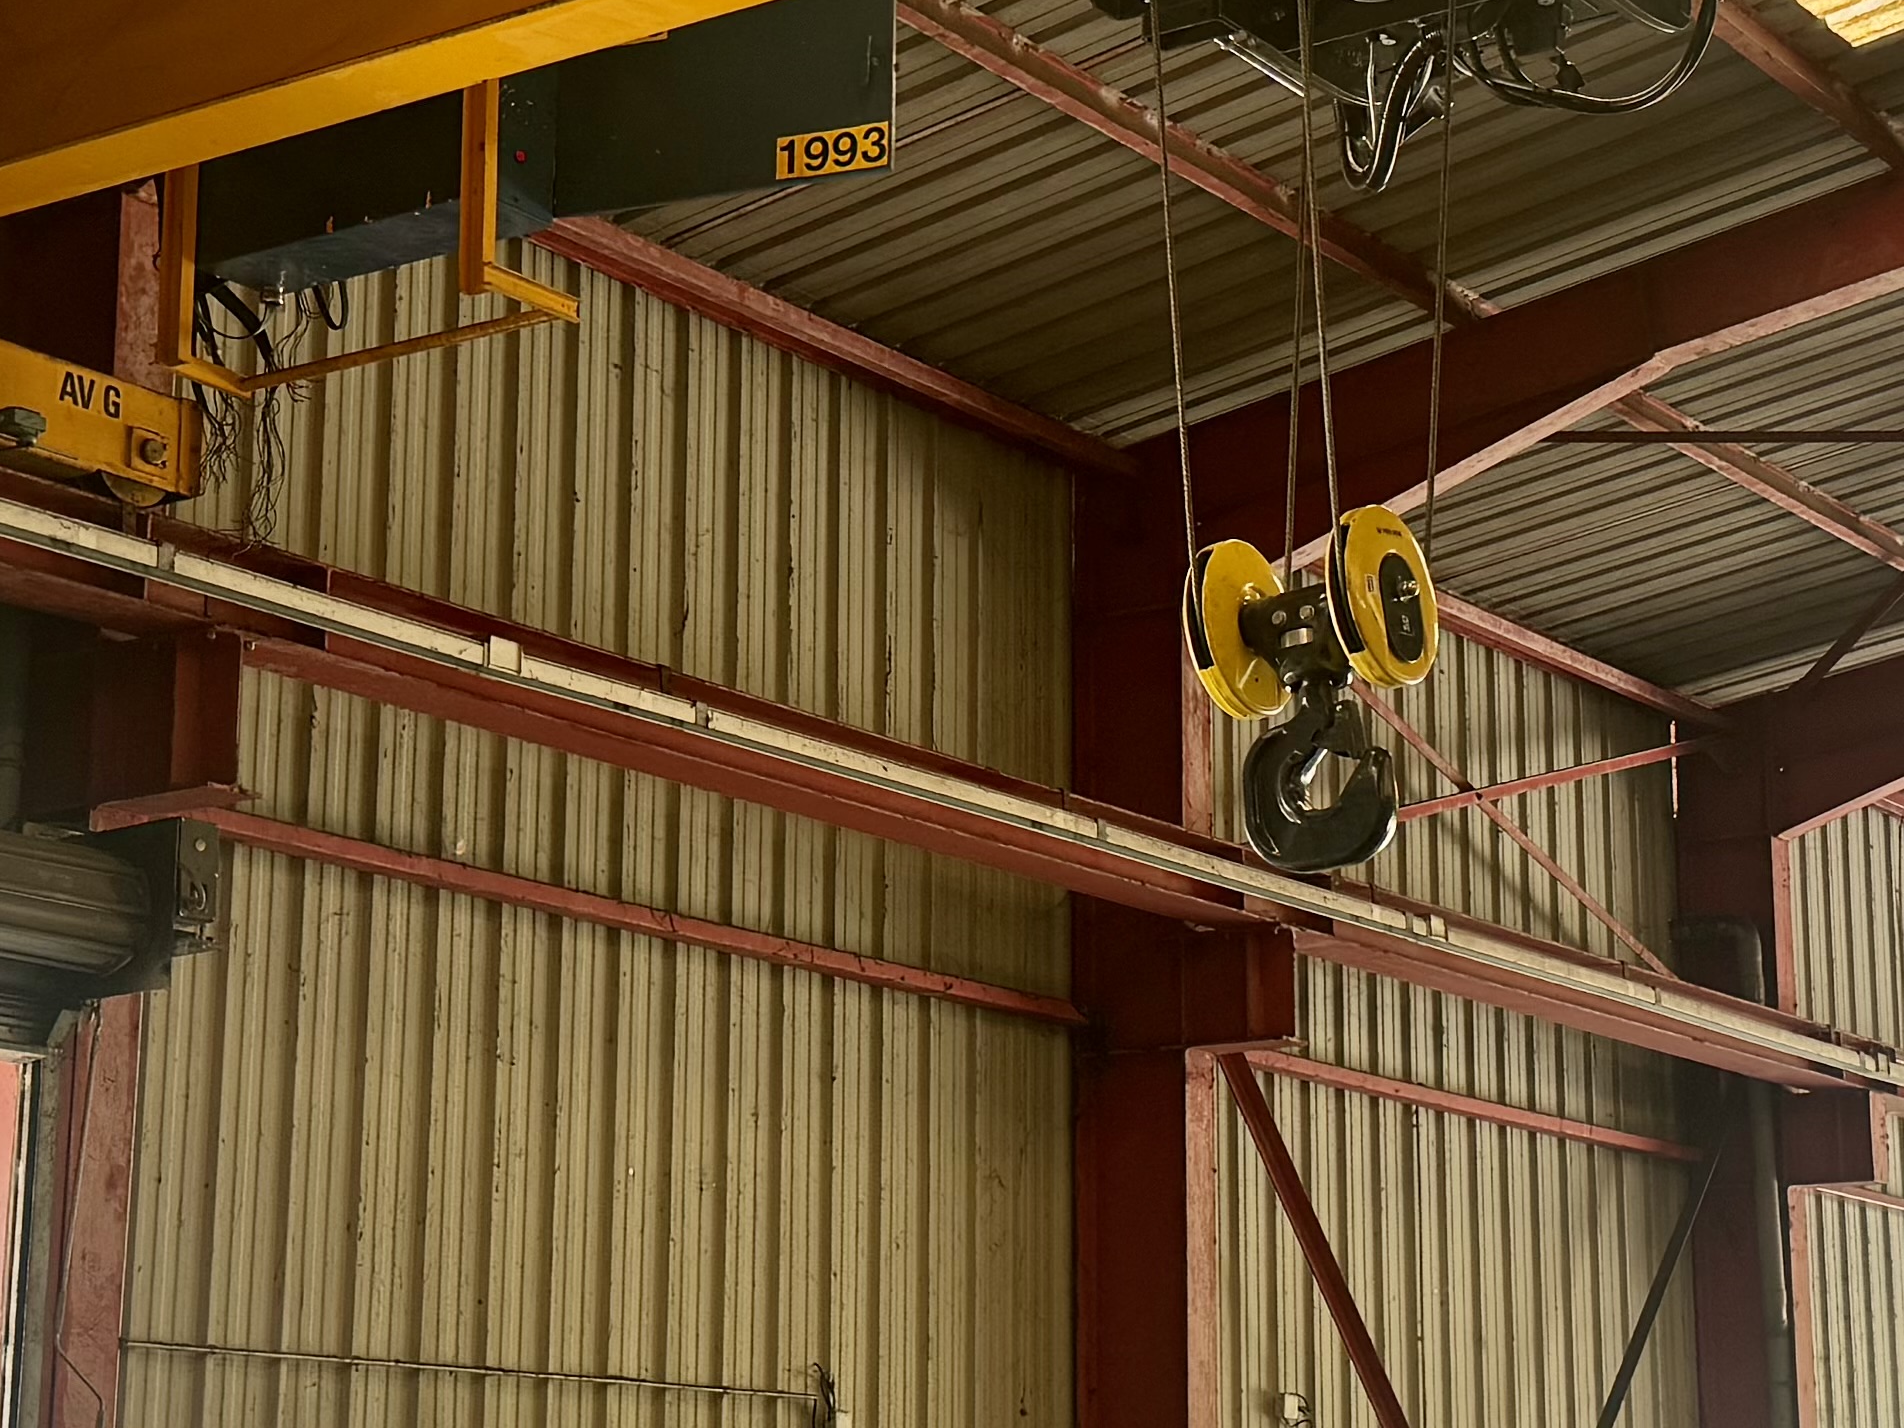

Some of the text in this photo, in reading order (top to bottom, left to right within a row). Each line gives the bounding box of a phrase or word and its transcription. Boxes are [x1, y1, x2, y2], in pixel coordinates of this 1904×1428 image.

[780, 127, 886, 174] 1993
[59, 371, 121, 420] AV G
